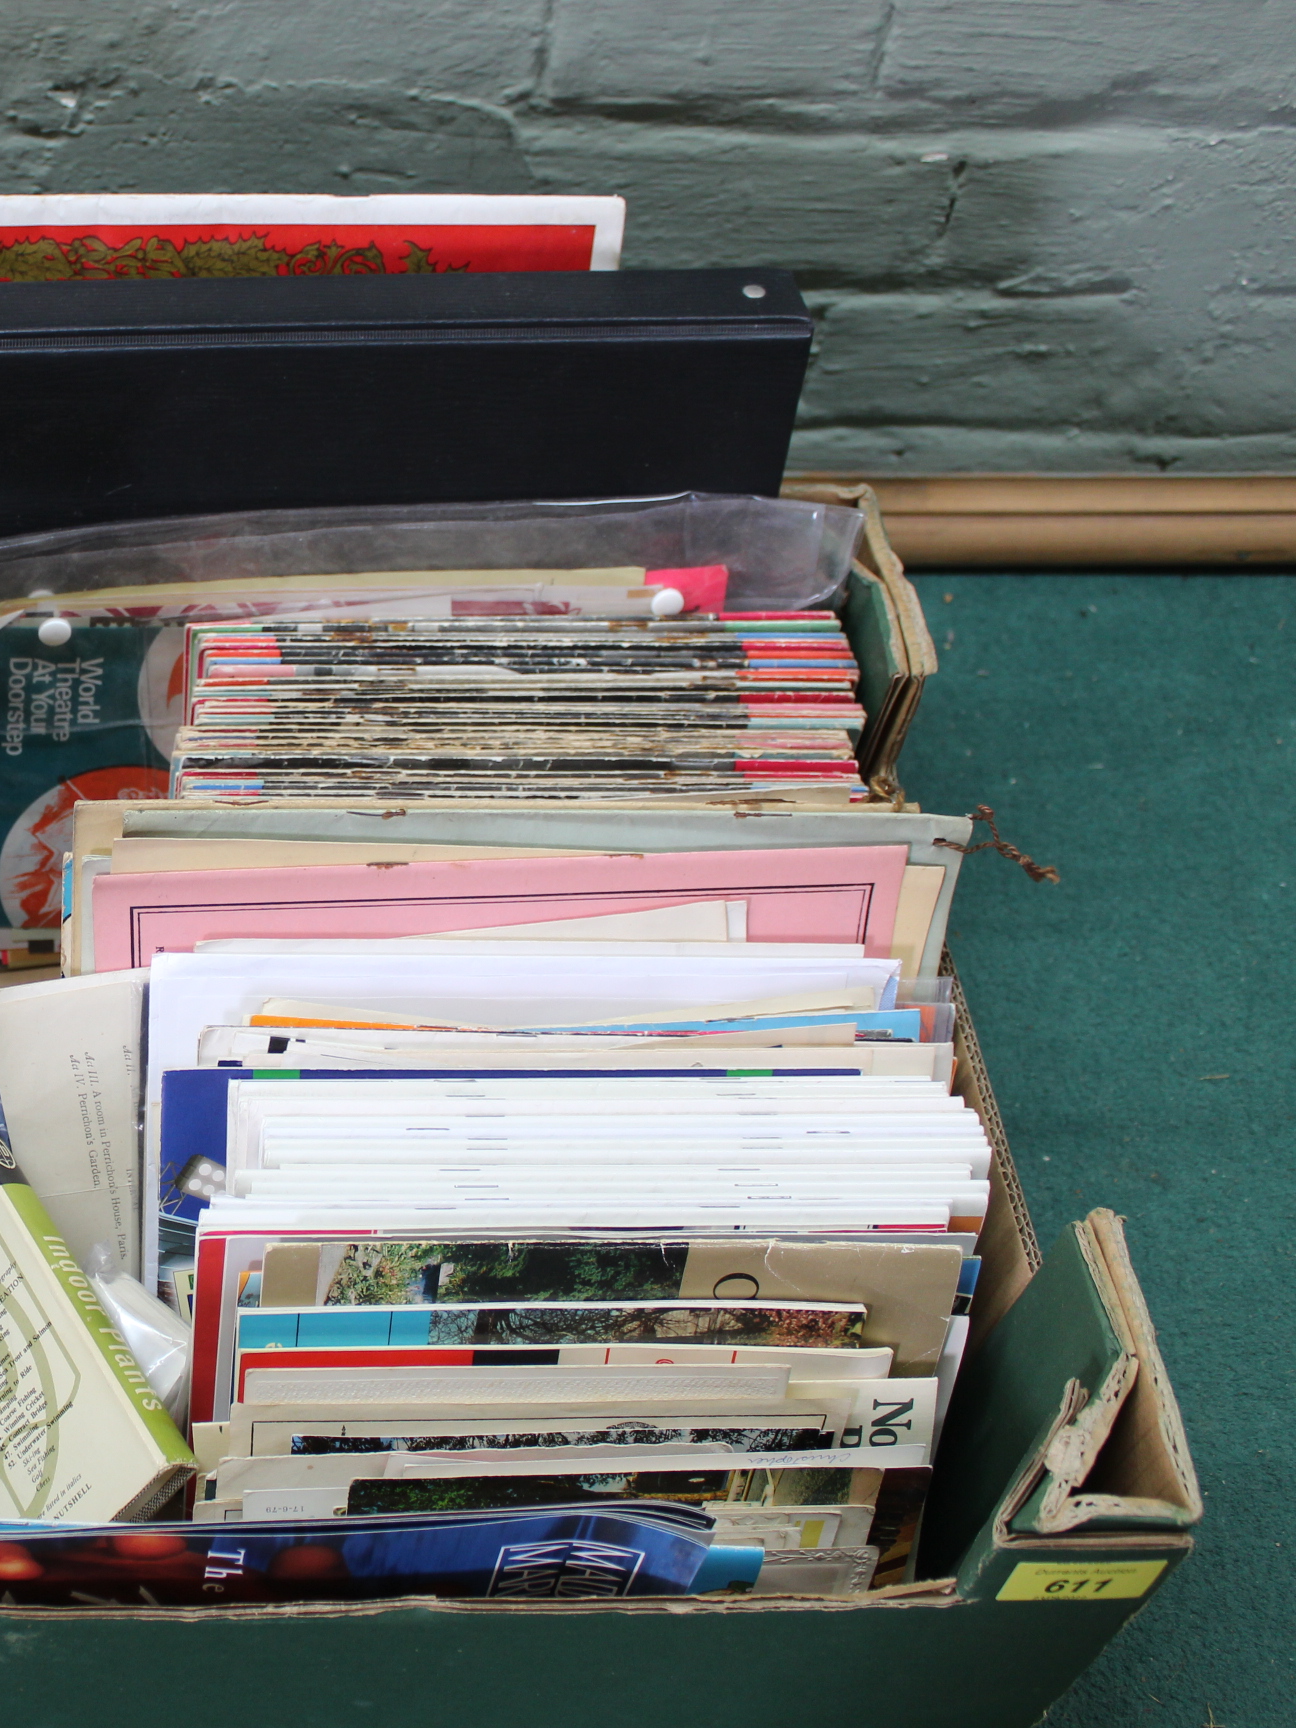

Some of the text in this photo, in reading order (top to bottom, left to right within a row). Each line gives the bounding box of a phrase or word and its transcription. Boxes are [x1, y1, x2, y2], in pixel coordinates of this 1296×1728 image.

[1, 657, 33, 756] Doorstep
[30, 658, 55, 735] At Your
[53, 657, 81, 742] Theatre
[77, 657, 104, 724] World
[85, 1052, 95, 1067] Act
[88, 1071, 99, 1086] III.
[70, 1055, 101, 1188] Act IV. Perrichon's Garden.
[95, 1101, 105, 1125] room
[100, 1128, 109, 1138] in
[102, 1141, 118, 1195] Perrichon's
[111, 1197, 122, 1230] House,
[117, 1233, 128, 1260] Paris.
[8, 1350, 23, 1368] Trout
[22, 1340, 33, 1353] and
[32, 1319, 52, 1343] Salmon
[43, 1236, 163, 1411] Indoor Plants
[12, 1421, 38, 1452] Swimming
[17, 1426, 46, 1460] Underwater
[45, 1398, 73, 1431] Swimming
[53, 1480, 91, 1523] NUTSHELL
[201, 1547, 247, 1593] The
[1044, 1577, 1114, 1594] 611
